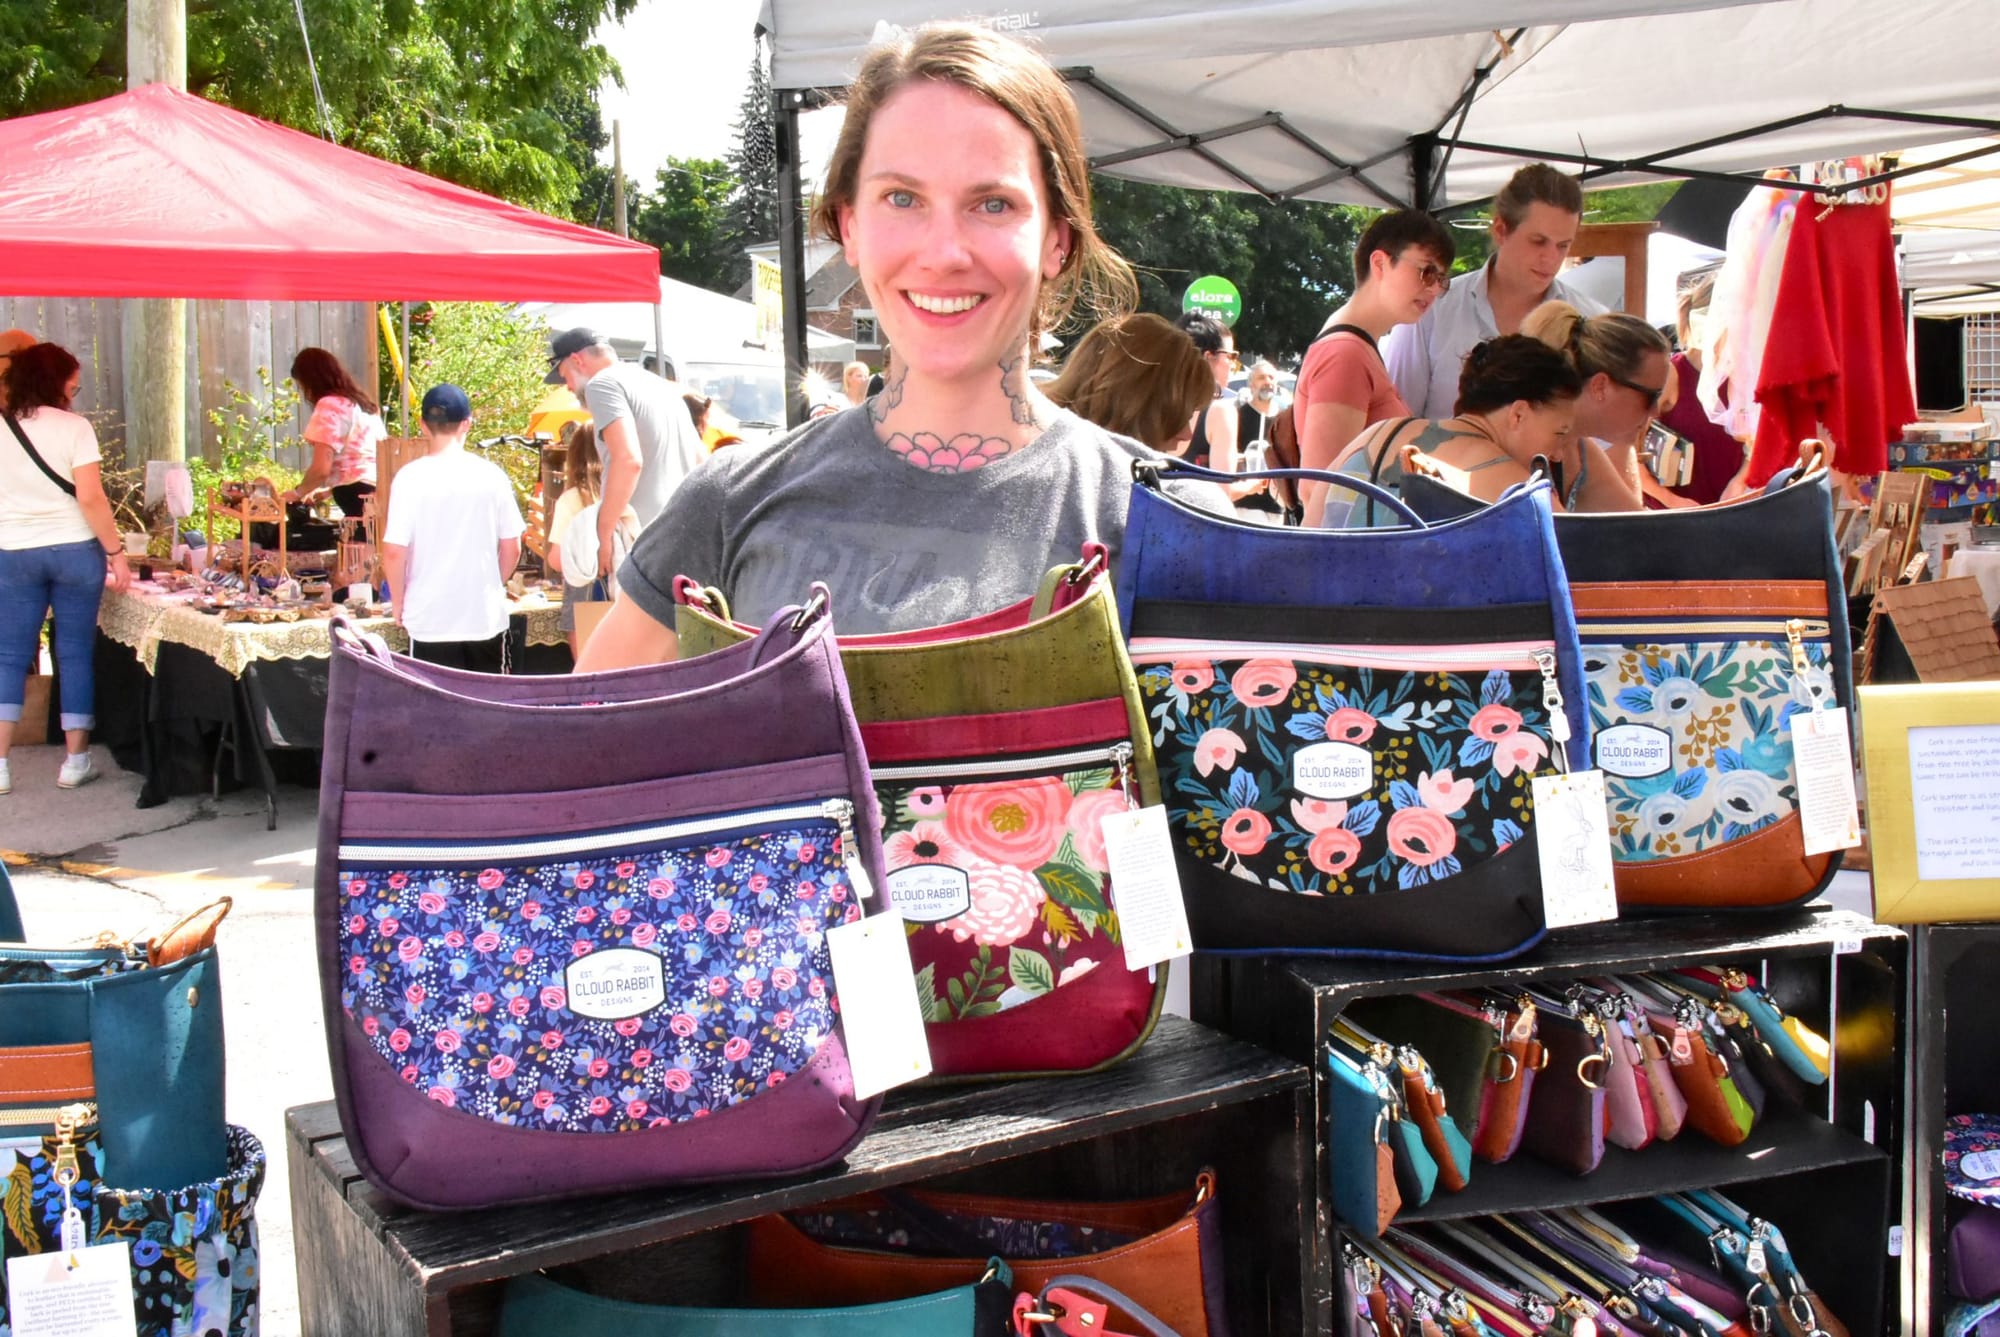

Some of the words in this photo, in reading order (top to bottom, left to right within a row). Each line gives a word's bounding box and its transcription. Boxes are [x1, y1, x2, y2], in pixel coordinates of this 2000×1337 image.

[1190, 289, 1233, 303] elora
[1602, 746, 1632, 758] CLOUD
[1633, 747, 1664, 758] RABBIT
[1299, 766, 1331, 778] CLOUD
[1333, 766, 1365, 778] RABBIT
[891, 889, 925, 902] CLOUD
[926, 887, 961, 900] RABBIT
[913, 903, 942, 911] DESIGNS
[575, 979, 614, 996] CLOUD
[616, 976, 655, 992] RABBIT
[601, 996, 633, 1007] DESIGNS
